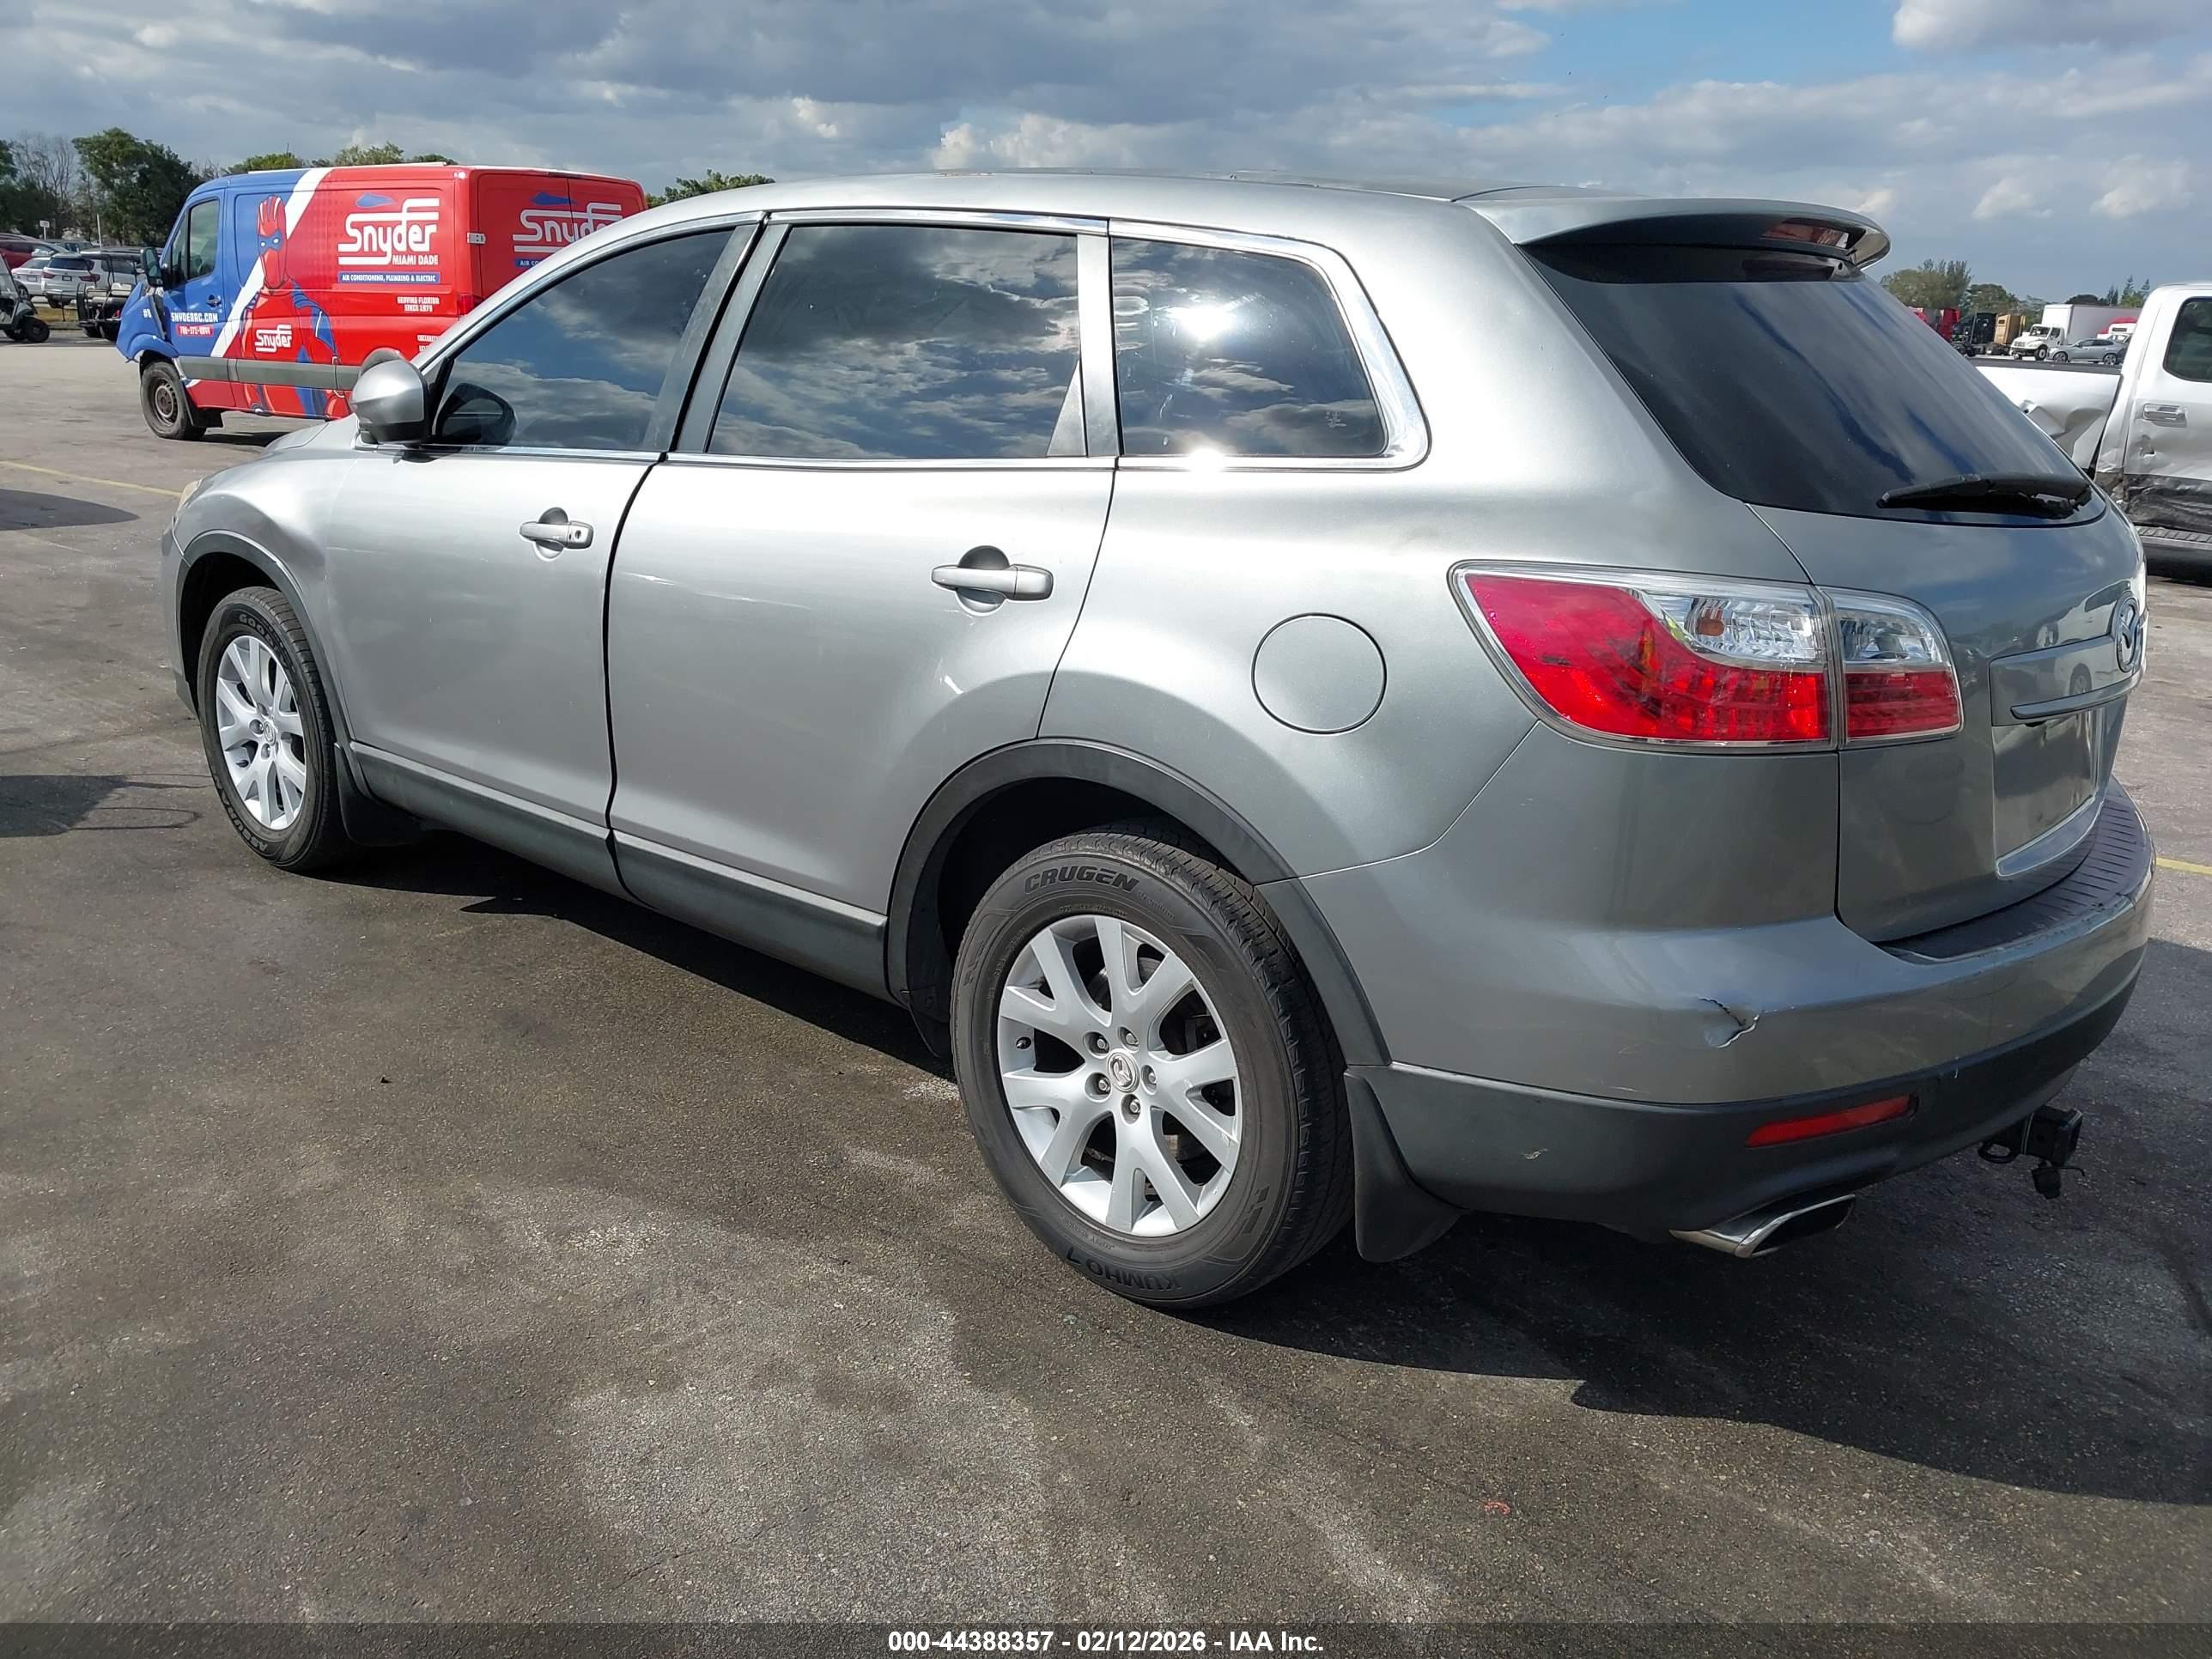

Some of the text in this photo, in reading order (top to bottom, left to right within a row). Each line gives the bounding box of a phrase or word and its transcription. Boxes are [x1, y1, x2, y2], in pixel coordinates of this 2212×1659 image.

[337, 198, 440, 265] Snyder
[392, 255, 439, 265] MIAMI DADE
[171, 312, 218, 323] SNYDERAC.COM
[255, 324, 293, 353] Snyder
[1024, 866, 1140, 895] CRUGEN
[1085, 1258, 1182, 1291] KUMHO
